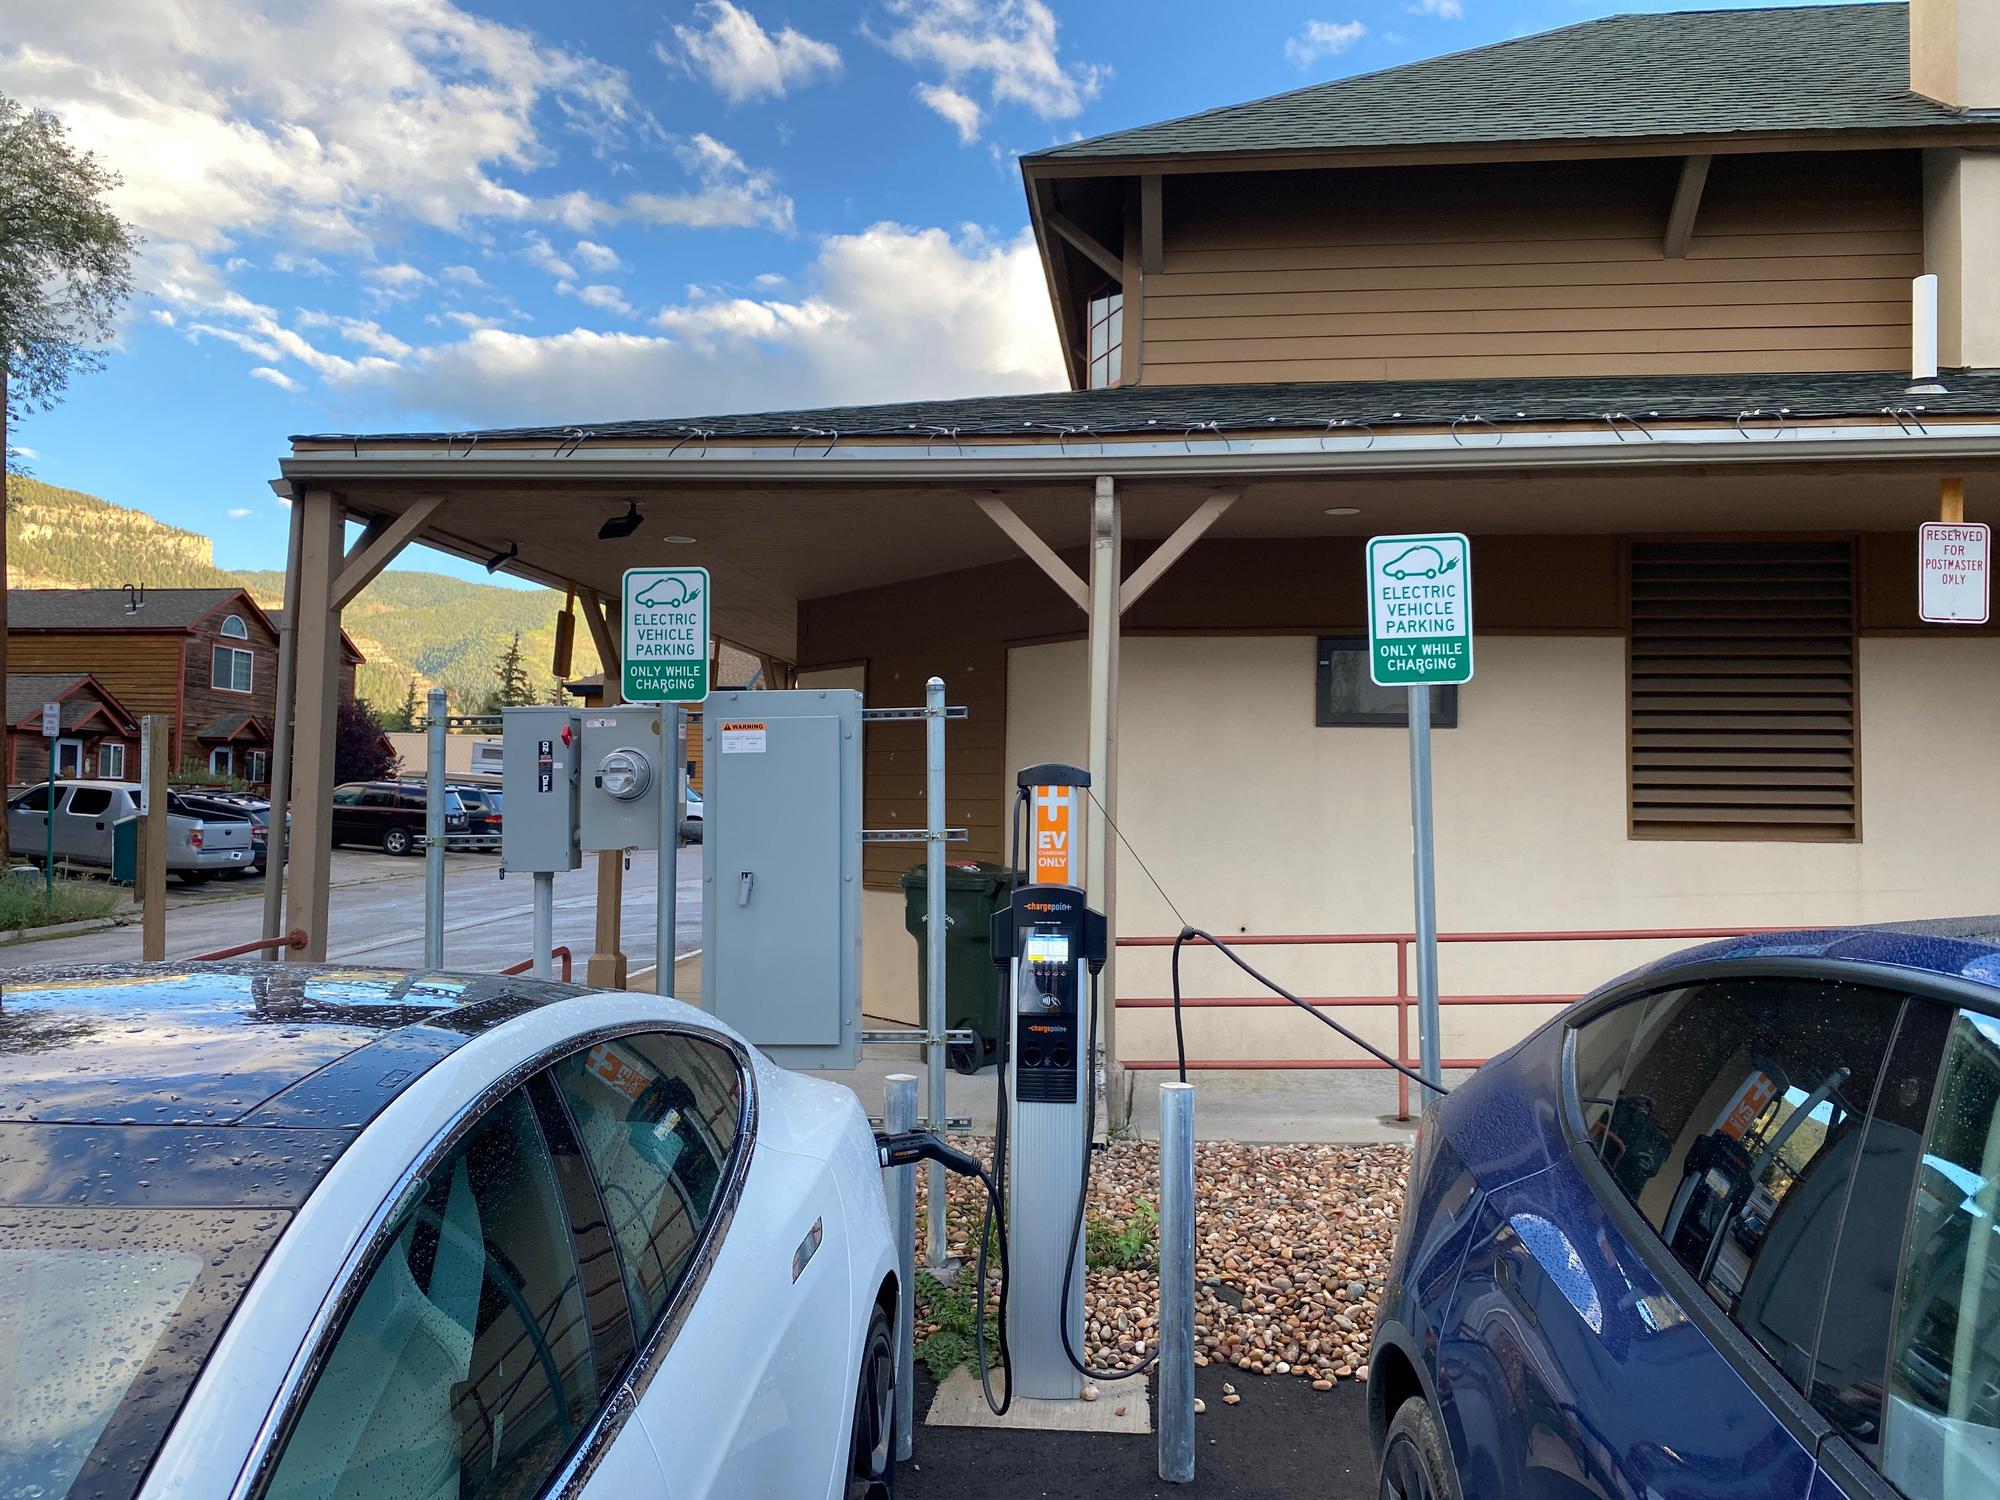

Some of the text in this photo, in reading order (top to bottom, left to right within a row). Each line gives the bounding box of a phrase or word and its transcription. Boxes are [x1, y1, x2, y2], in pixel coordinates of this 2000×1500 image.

[1926, 530, 1983, 541] RESERVED
[1944, 545, 1965, 555] FOR
[1925, 559, 1983, 571] POSTMASTER
[1942, 574, 1966, 585] ONLY
[1383, 585, 1456, 600] ELECTRIC
[1387, 602, 1453, 617] VEHICLE
[634, 613, 697, 625] ELECTRIC
[1386, 619, 1455, 633] PARKING
[638, 628, 694, 640] VEHICLE
[636, 644, 695, 656] PARKING
[1380, 643, 1462, 657] ONLY WHILE
[1387, 658, 1457, 671] CHARGING
[630, 666, 701, 677] ONLY WHILE
[636, 679, 695, 690] CHARGING
[542, 741, 550, 752] ON
[542, 775, 550, 792] OFF
[1038, 831, 1067, 849] EV
[1038, 857, 1067, 868] ONLY
[1024, 902, 1072, 912] chargepoint
